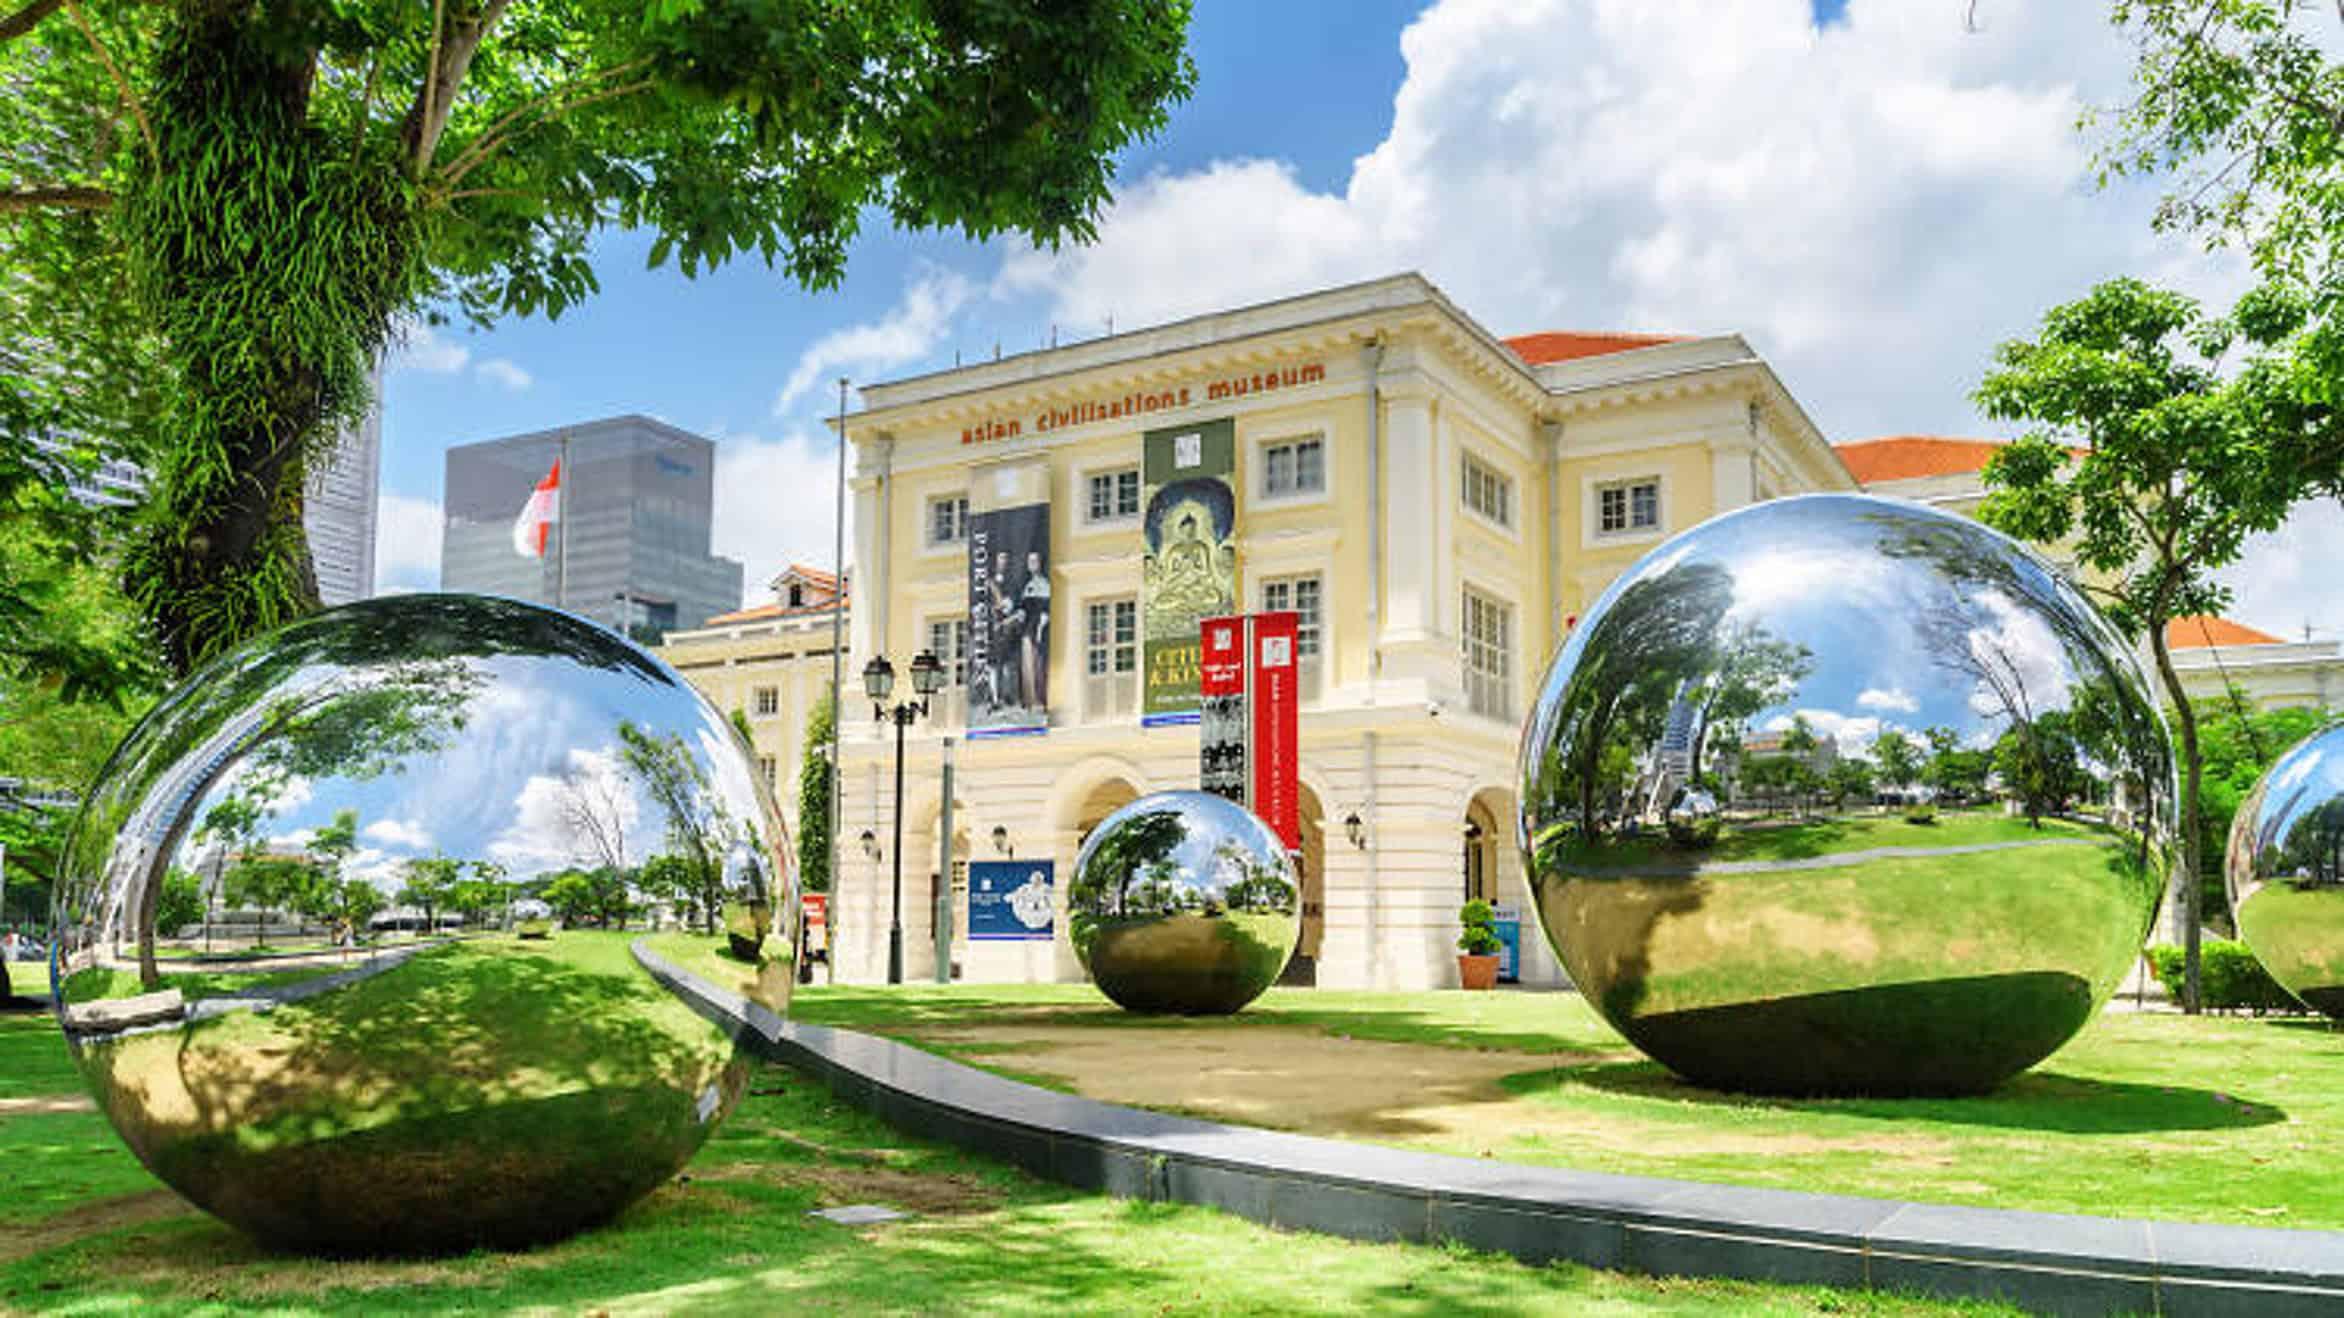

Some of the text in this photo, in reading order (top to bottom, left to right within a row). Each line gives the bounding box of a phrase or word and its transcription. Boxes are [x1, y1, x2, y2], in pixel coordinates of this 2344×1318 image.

[961, 365, 1326, 444] asian civilisations museum
[973, 531, 989, 594] PORT
